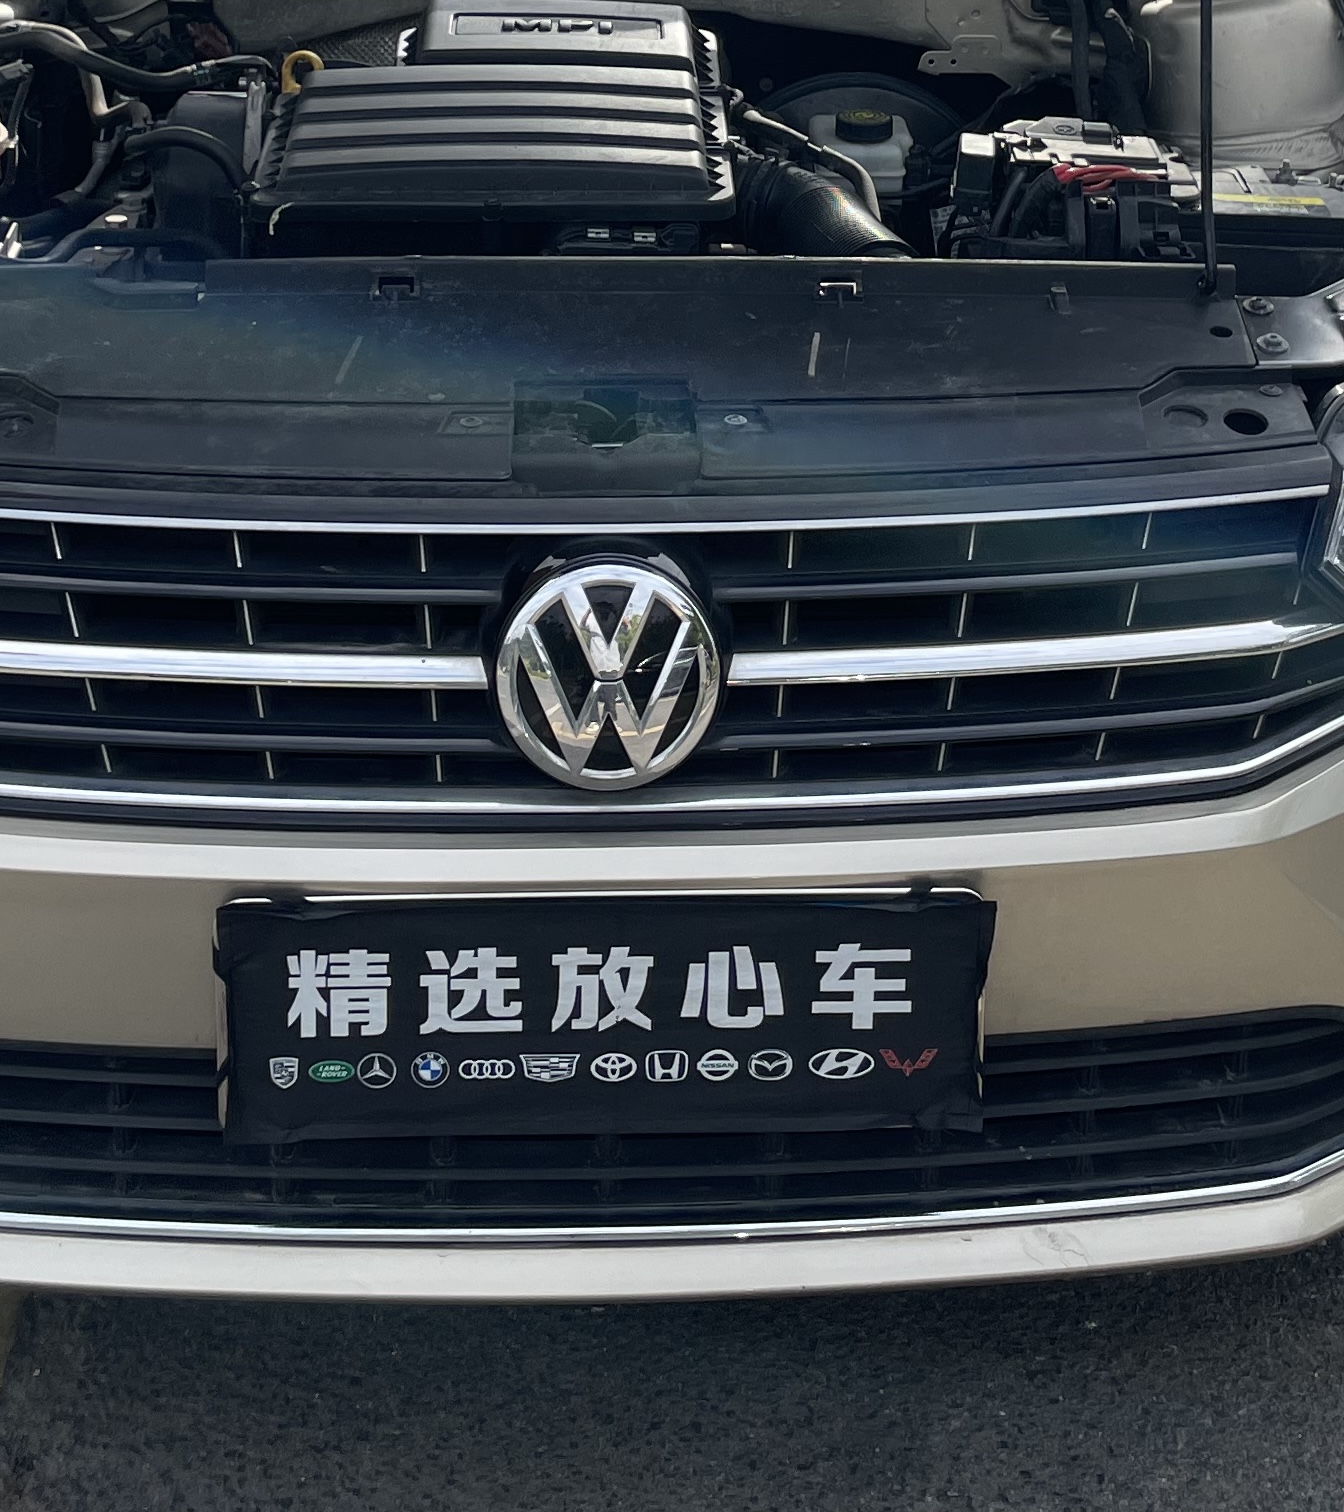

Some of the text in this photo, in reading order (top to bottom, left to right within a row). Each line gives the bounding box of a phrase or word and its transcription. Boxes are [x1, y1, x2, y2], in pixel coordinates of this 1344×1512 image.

[501, 18, 613, 35] MPI
[286, 943, 913, 1039] 精选放心车
